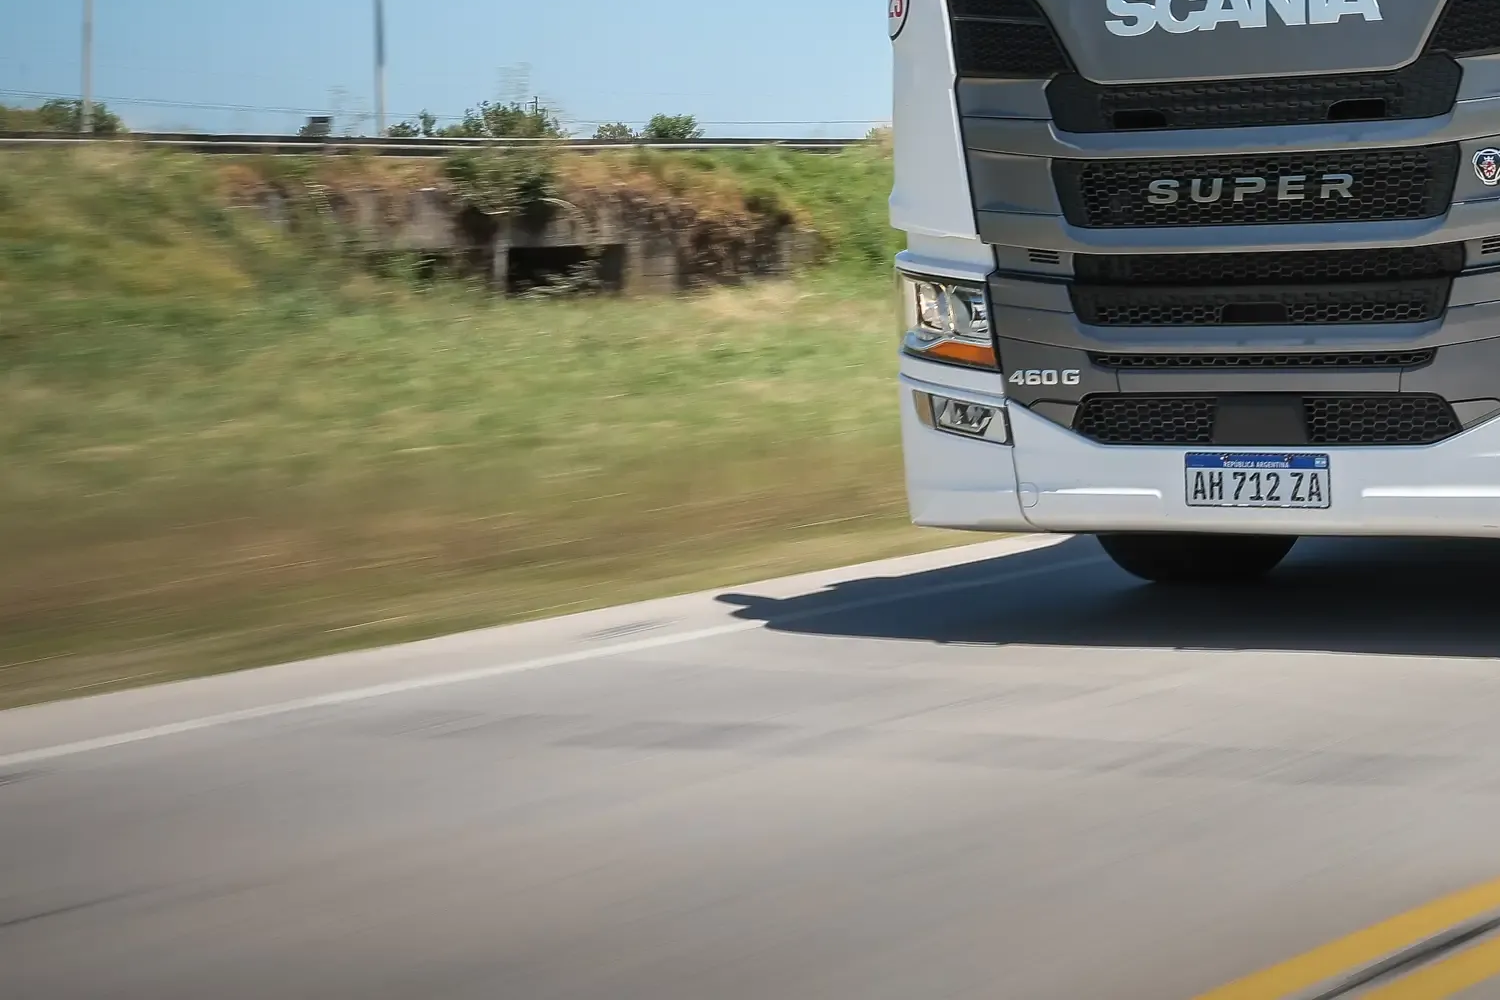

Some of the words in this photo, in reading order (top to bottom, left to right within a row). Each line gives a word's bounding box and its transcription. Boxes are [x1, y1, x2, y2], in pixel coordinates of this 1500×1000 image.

[1147, 172, 1356, 206] SUPER
[1008, 369, 1059, 386] 460
[1061, 369, 1081, 385] G
[1223, 460, 1255, 468] REPÚBLICA
[1255, 461, 1290, 469] ARGENTINA
[1192, 471, 1224, 501] AH
[1232, 471, 1281, 501] 712
[1289, 472, 1323, 502] ZA
